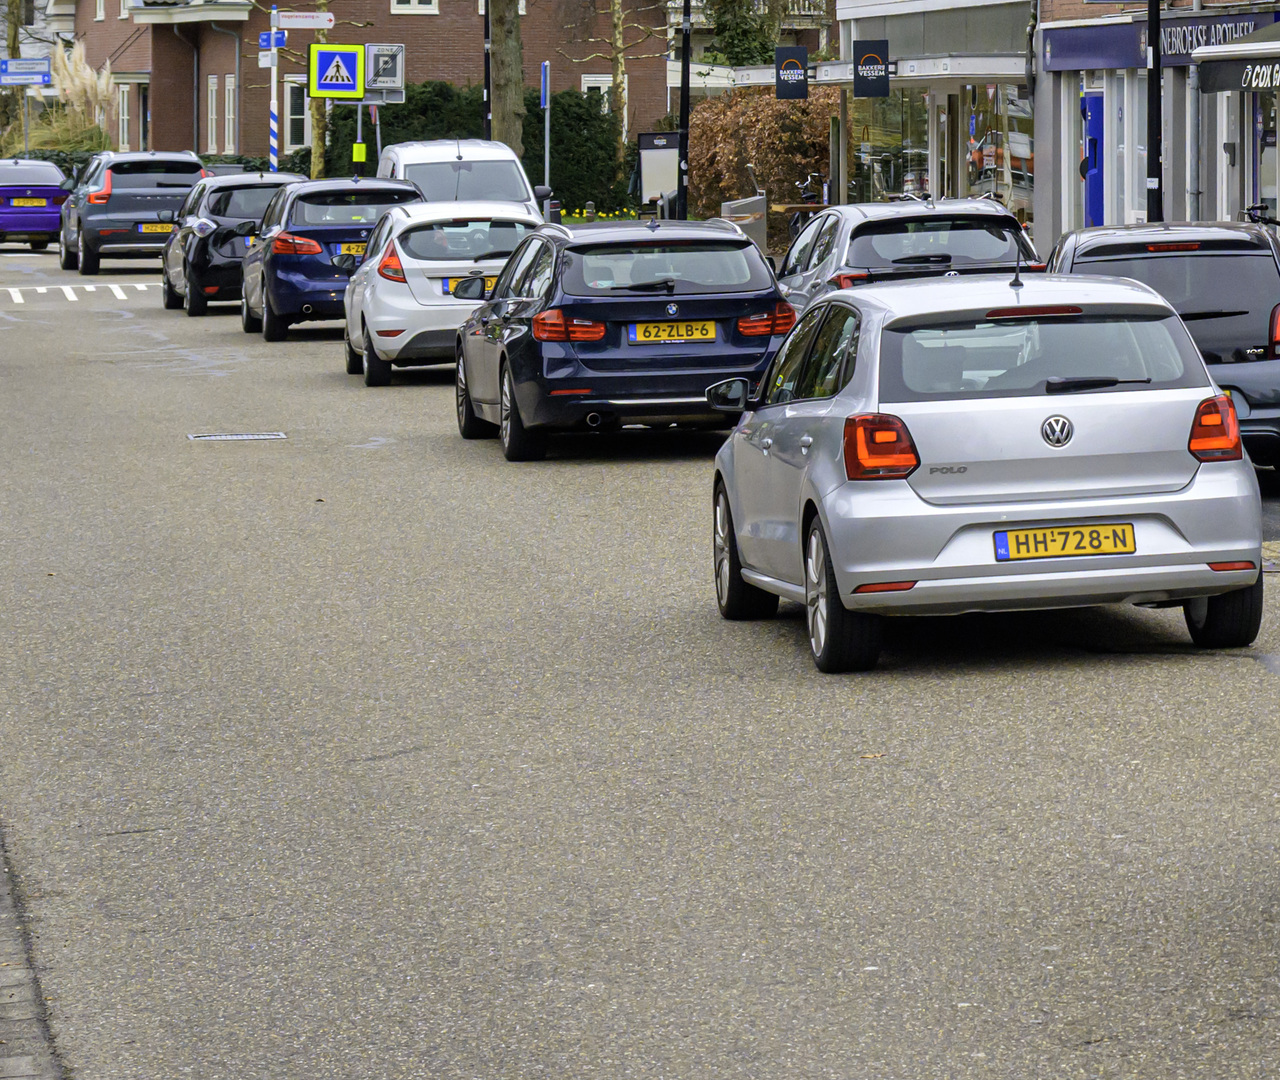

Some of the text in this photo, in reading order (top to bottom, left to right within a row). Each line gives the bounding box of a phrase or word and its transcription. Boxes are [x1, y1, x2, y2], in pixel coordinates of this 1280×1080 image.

[1161, 25, 1207, 55] NEBROEKSE
[1251, 64, 1273, 88] COX
[643, 323, 709, 339] 62-ZLB-6
[929, 466, 968, 475] POLO
[998, 547, 1008, 556] NL
